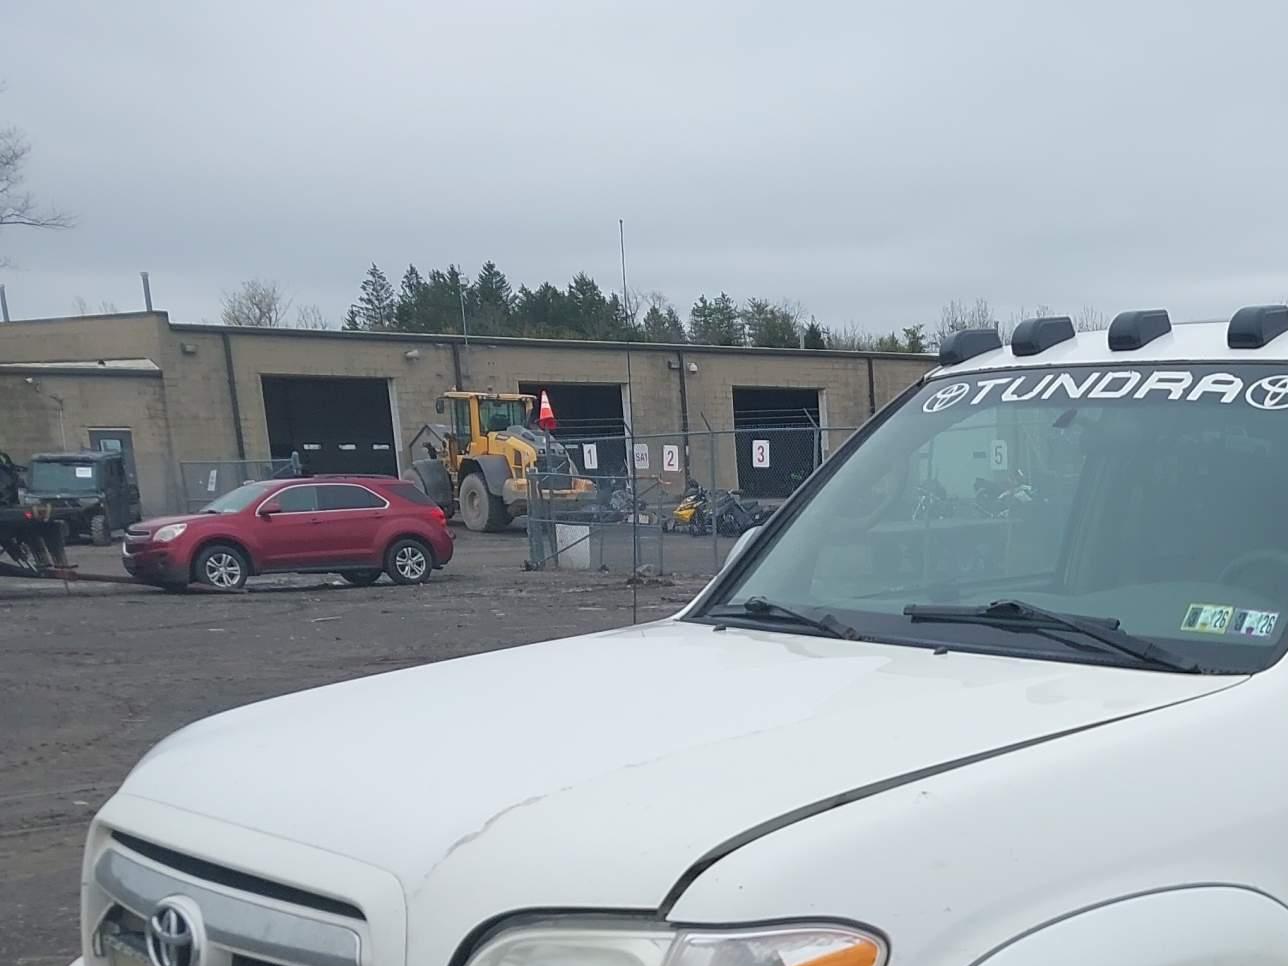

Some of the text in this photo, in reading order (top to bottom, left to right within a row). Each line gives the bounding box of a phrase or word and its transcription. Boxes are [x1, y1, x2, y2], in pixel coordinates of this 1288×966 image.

[969, 370, 1244, 404] TUNDRA
[587, 449, 593, 465] 1
[667, 450, 674, 467] 2
[757, 445, 765, 463] 3
[994, 445, 1003, 465] 5
